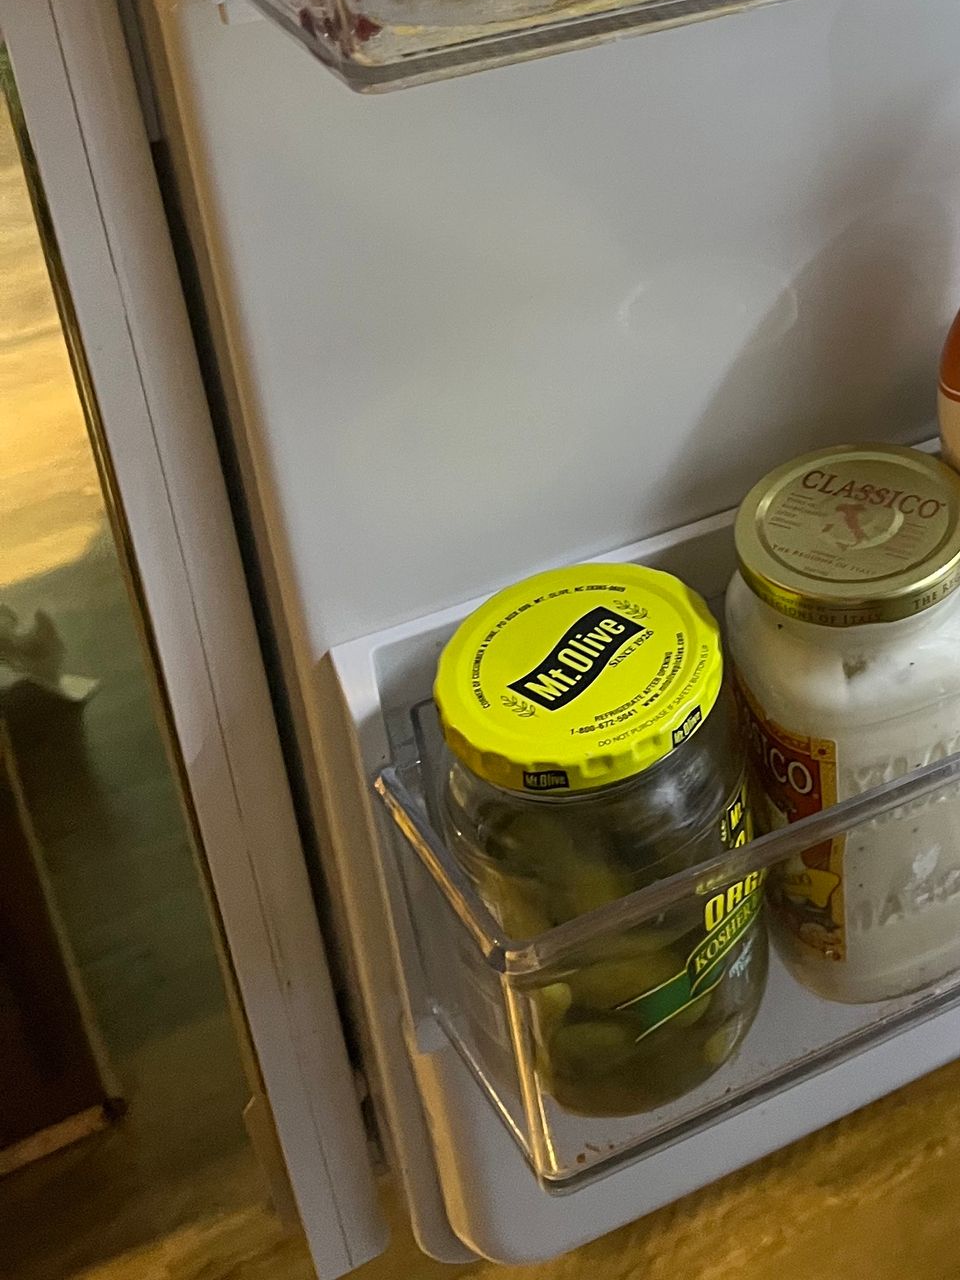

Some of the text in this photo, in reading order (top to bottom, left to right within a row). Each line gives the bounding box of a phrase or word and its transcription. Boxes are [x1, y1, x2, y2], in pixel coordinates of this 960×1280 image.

[802, 469, 940, 520] CLASSICO
[913, 592, 938, 610] THE
[609, 630, 654, 668] SINCE 1926
[594, 693, 644, 722] REFRIGERATE
[643, 677, 662, 695] AFTER
[598, 738, 612, 748] DO
[612, 730, 630, 743] NOT
[630, 709, 669, 735] PURCHASE
[674, 684, 693, 705] SAFETY
[689, 658, 706, 687] BUTTON
